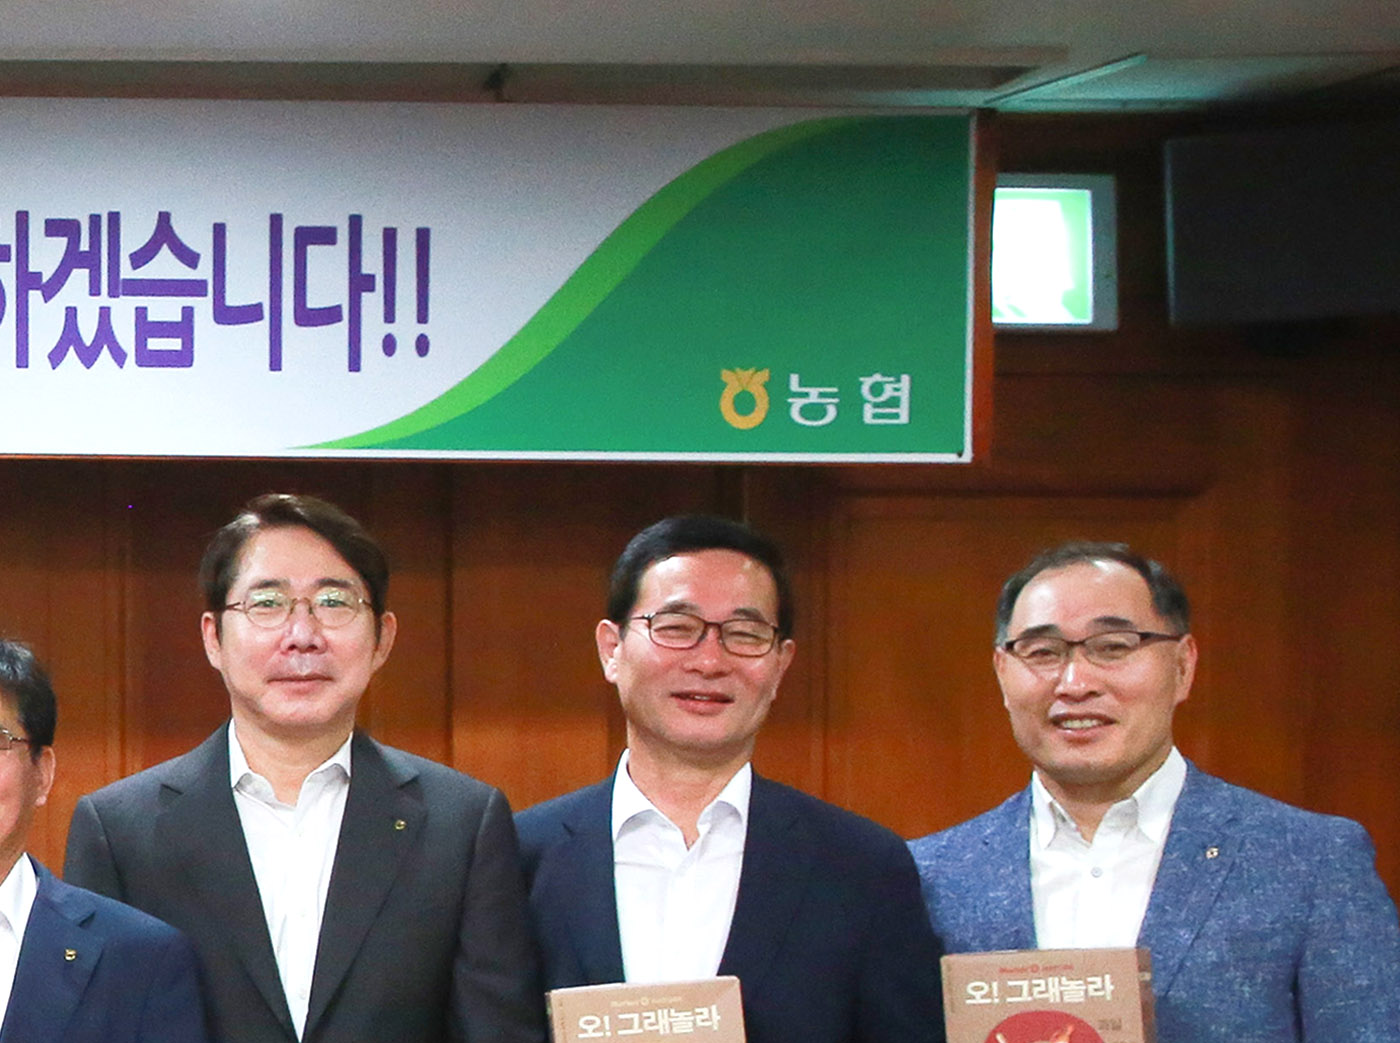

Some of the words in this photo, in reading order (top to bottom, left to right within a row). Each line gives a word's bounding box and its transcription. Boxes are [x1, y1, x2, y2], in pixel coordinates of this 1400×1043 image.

[965, 981, 999, 1005] 오!
[1006, 974, 1115, 1004] 그래놀라
[577, 1015, 612, 1039] 오!
[617, 1004, 721, 1036] 그래놀라
